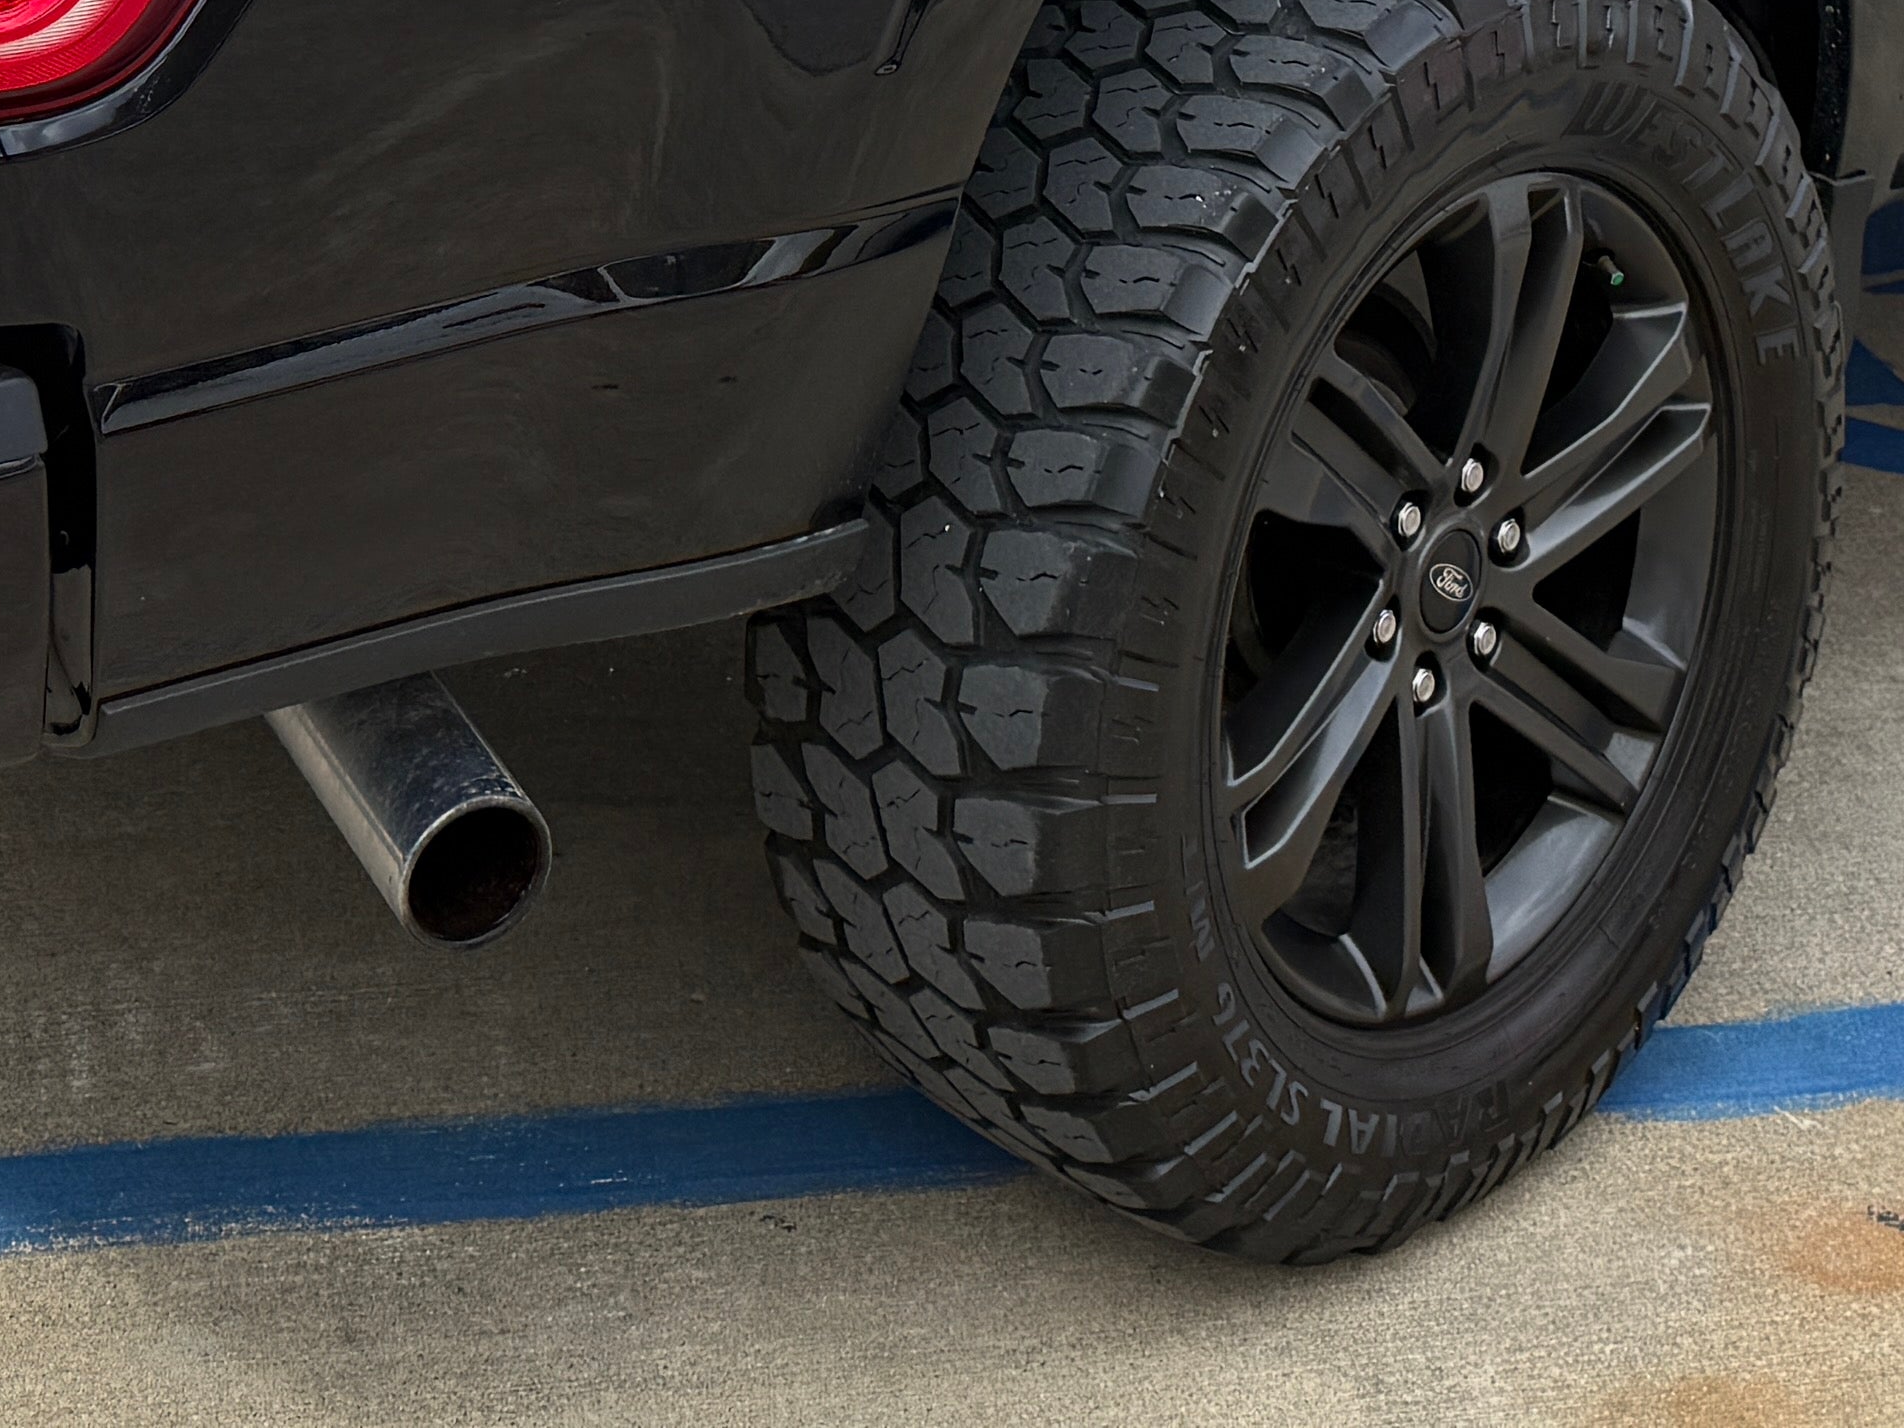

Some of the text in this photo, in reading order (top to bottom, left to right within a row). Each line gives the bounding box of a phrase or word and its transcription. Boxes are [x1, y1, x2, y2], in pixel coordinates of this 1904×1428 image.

[1560, 79, 1800, 365] WESTLAKE
[1436, 567, 1468, 598] Ford
[1212, 982, 1309, 1126] SL376
[1319, 1080, 1511, 1155] RADIAL
